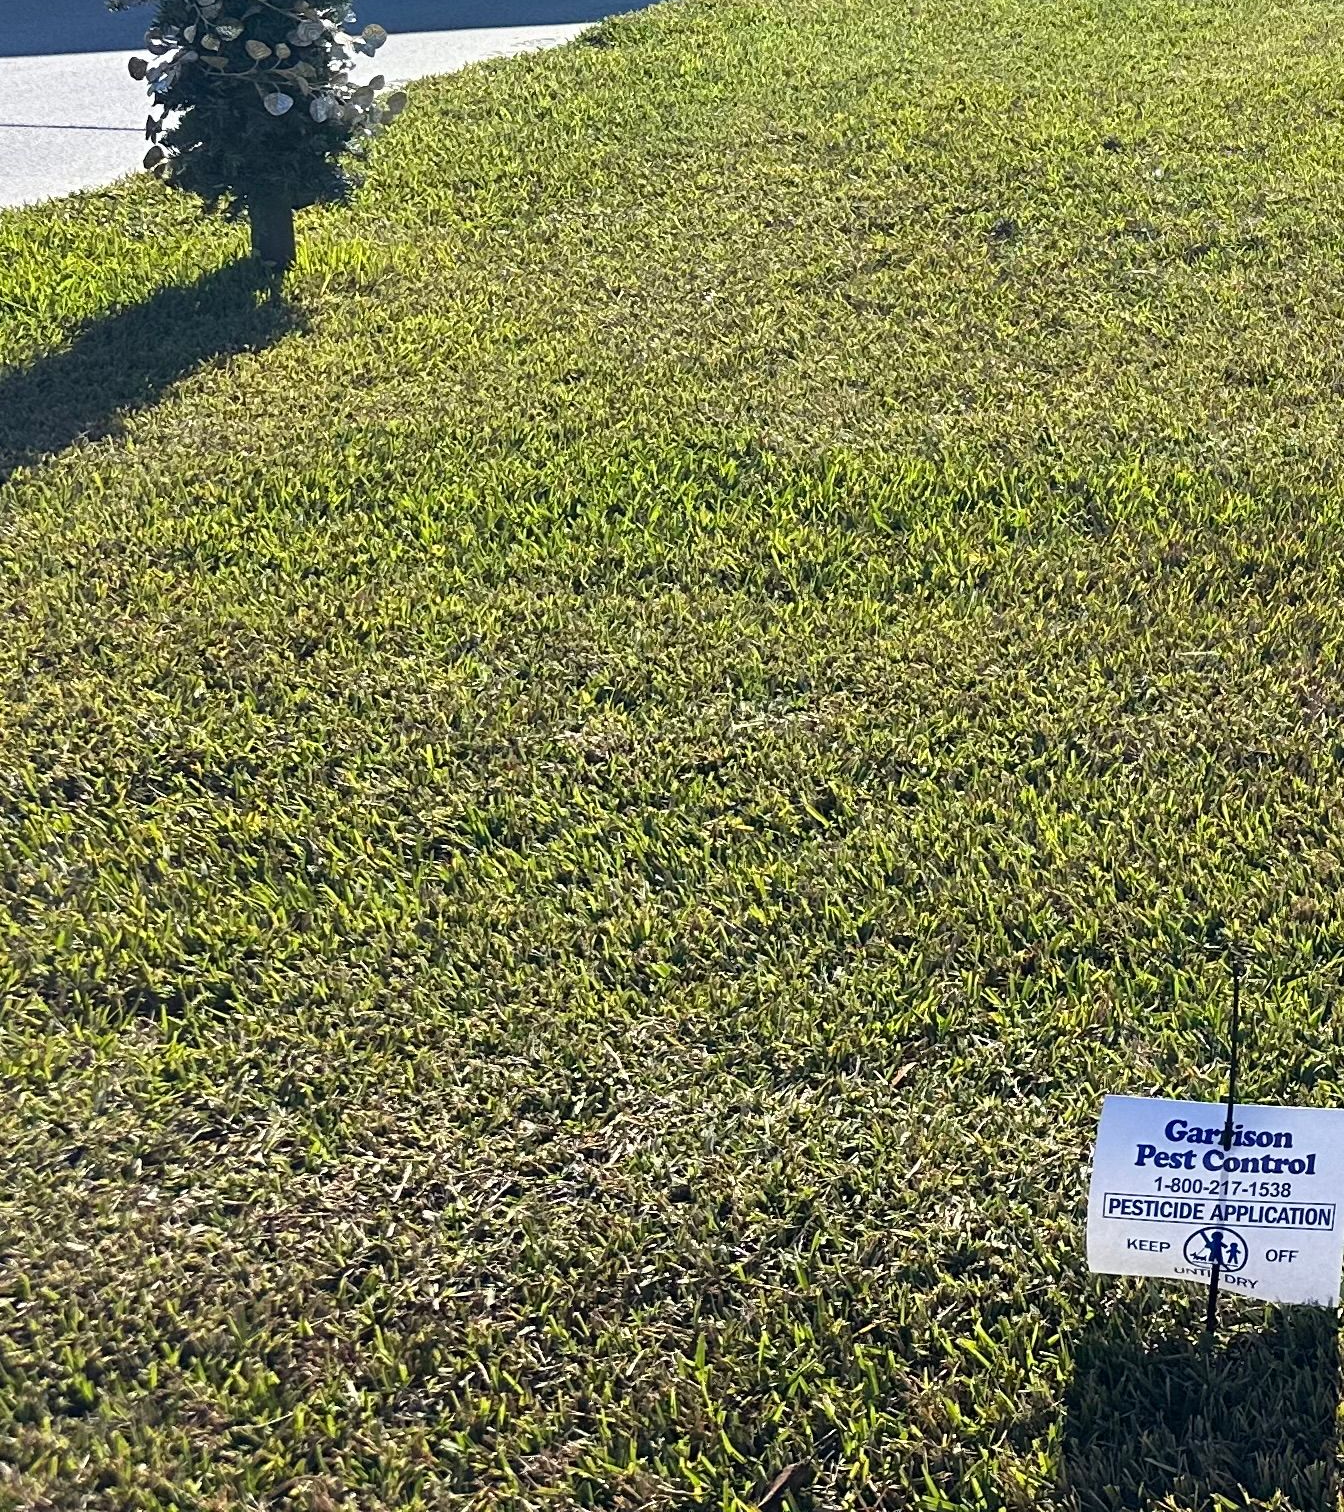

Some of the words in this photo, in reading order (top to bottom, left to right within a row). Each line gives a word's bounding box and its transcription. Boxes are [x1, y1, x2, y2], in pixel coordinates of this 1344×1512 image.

[1135, 1144, 1197, 1169] Pest
[1203, 1149, 1316, 1175] Control
[1154, 1176, 1292, 1198] 1-800-217-1538
[1109, 1198, 1204, 1220] PESTICIDE
[1210, 1203, 1332, 1227] APPLICATION
[1127, 1238, 1171, 1253] KEEP
[1265, 1249, 1299, 1263] OFF
[1174, 1267, 1220, 1281] UNTI
[1225, 1274, 1258, 1289] DRY
